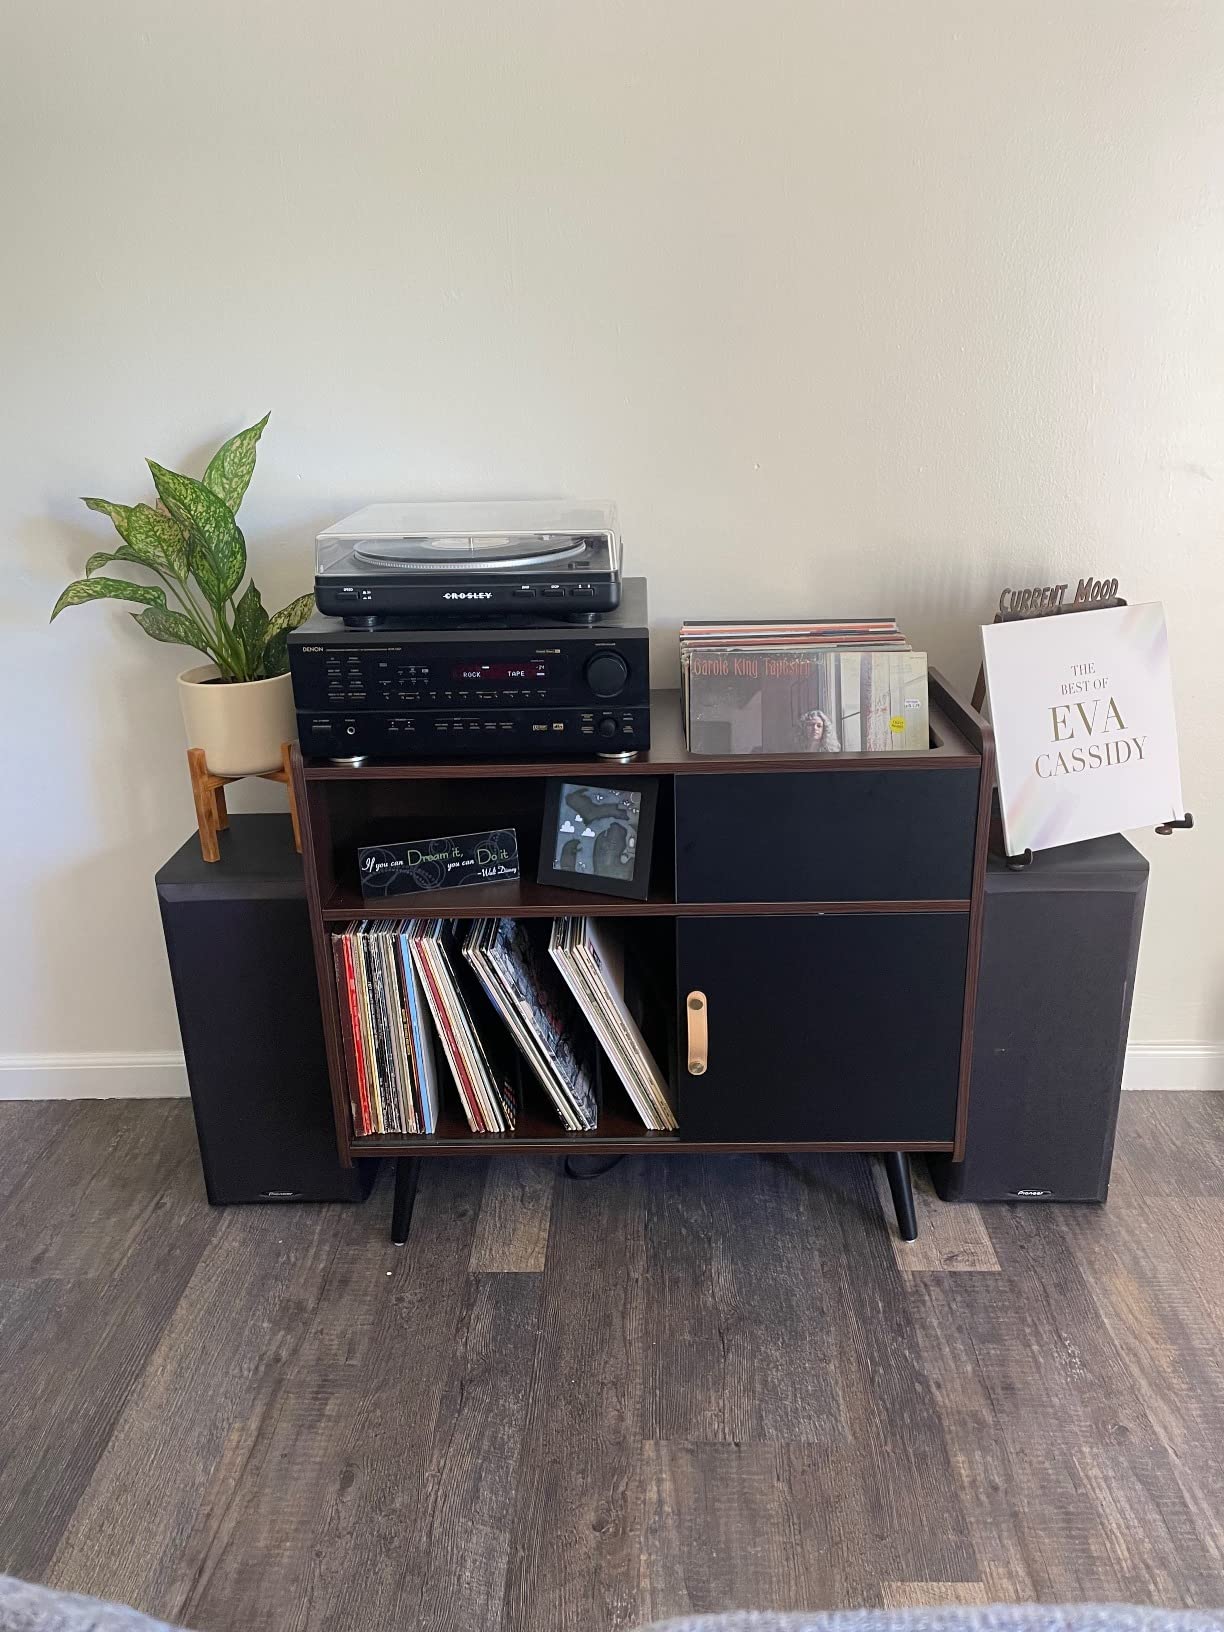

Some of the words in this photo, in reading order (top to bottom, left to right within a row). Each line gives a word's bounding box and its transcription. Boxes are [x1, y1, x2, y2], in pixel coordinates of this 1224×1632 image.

[1000, 584, 1068, 613] CURRENT
[694, 658, 729, 676] Carole
[734, 658, 758, 679] King
[1071, 662, 1096, 676] THE
[1061, 680, 1090, 695] BEST
[1093, 677, 1109, 690] OF
[1048, 696, 1129, 743] EVA
[1035, 736, 1148, 779] CASSIDY
[361, 857, 376, 872] If
[375, 862, 388, 872] you
[407, 849, 449, 866] Dream
[447, 862, 460, 872] you
[477, 848, 498, 865] Do
[500, 848, 509, 859] it
